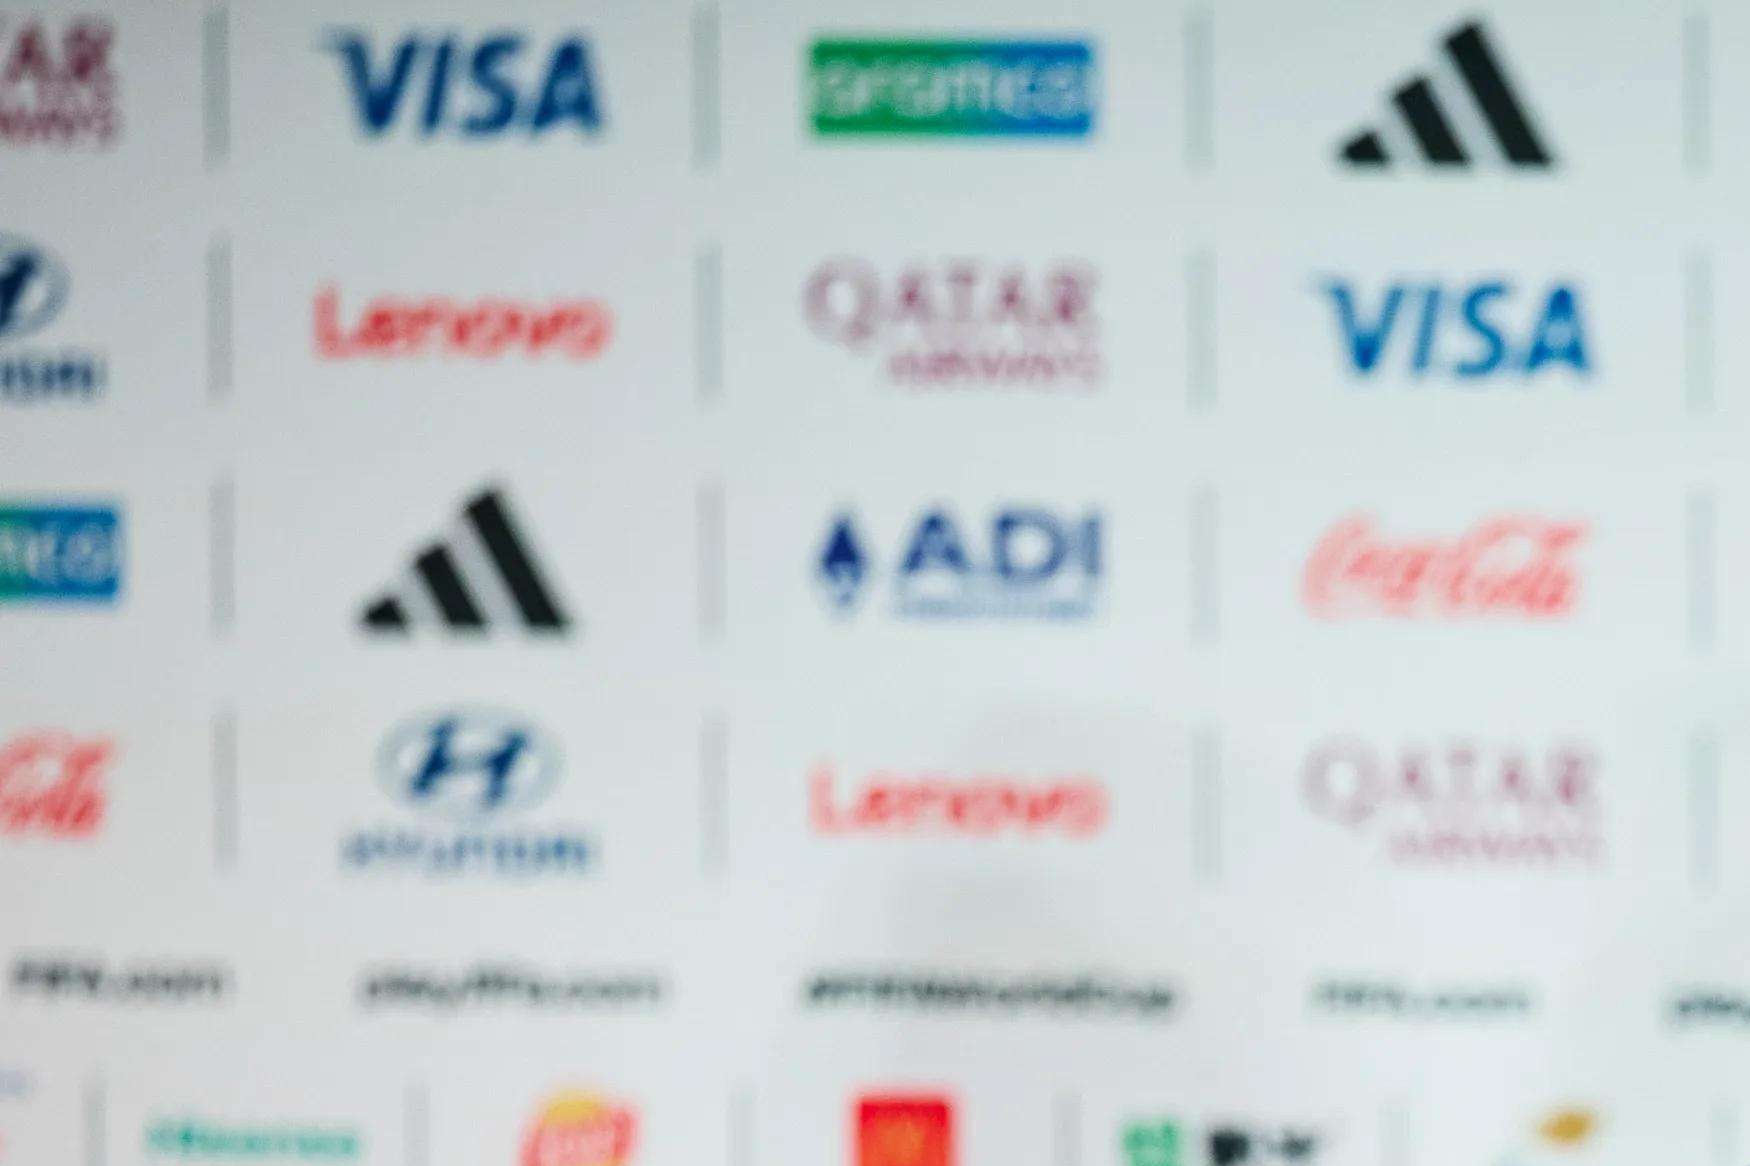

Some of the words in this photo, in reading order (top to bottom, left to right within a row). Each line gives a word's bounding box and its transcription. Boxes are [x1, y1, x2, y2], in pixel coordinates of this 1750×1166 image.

[332, 32, 601, 137] VISA
[314, 287, 609, 358] Lenovo
[803, 261, 1096, 350] QATAR
[1320, 281, 1592, 380] VISA
[897, 508, 1102, 579] ADI
